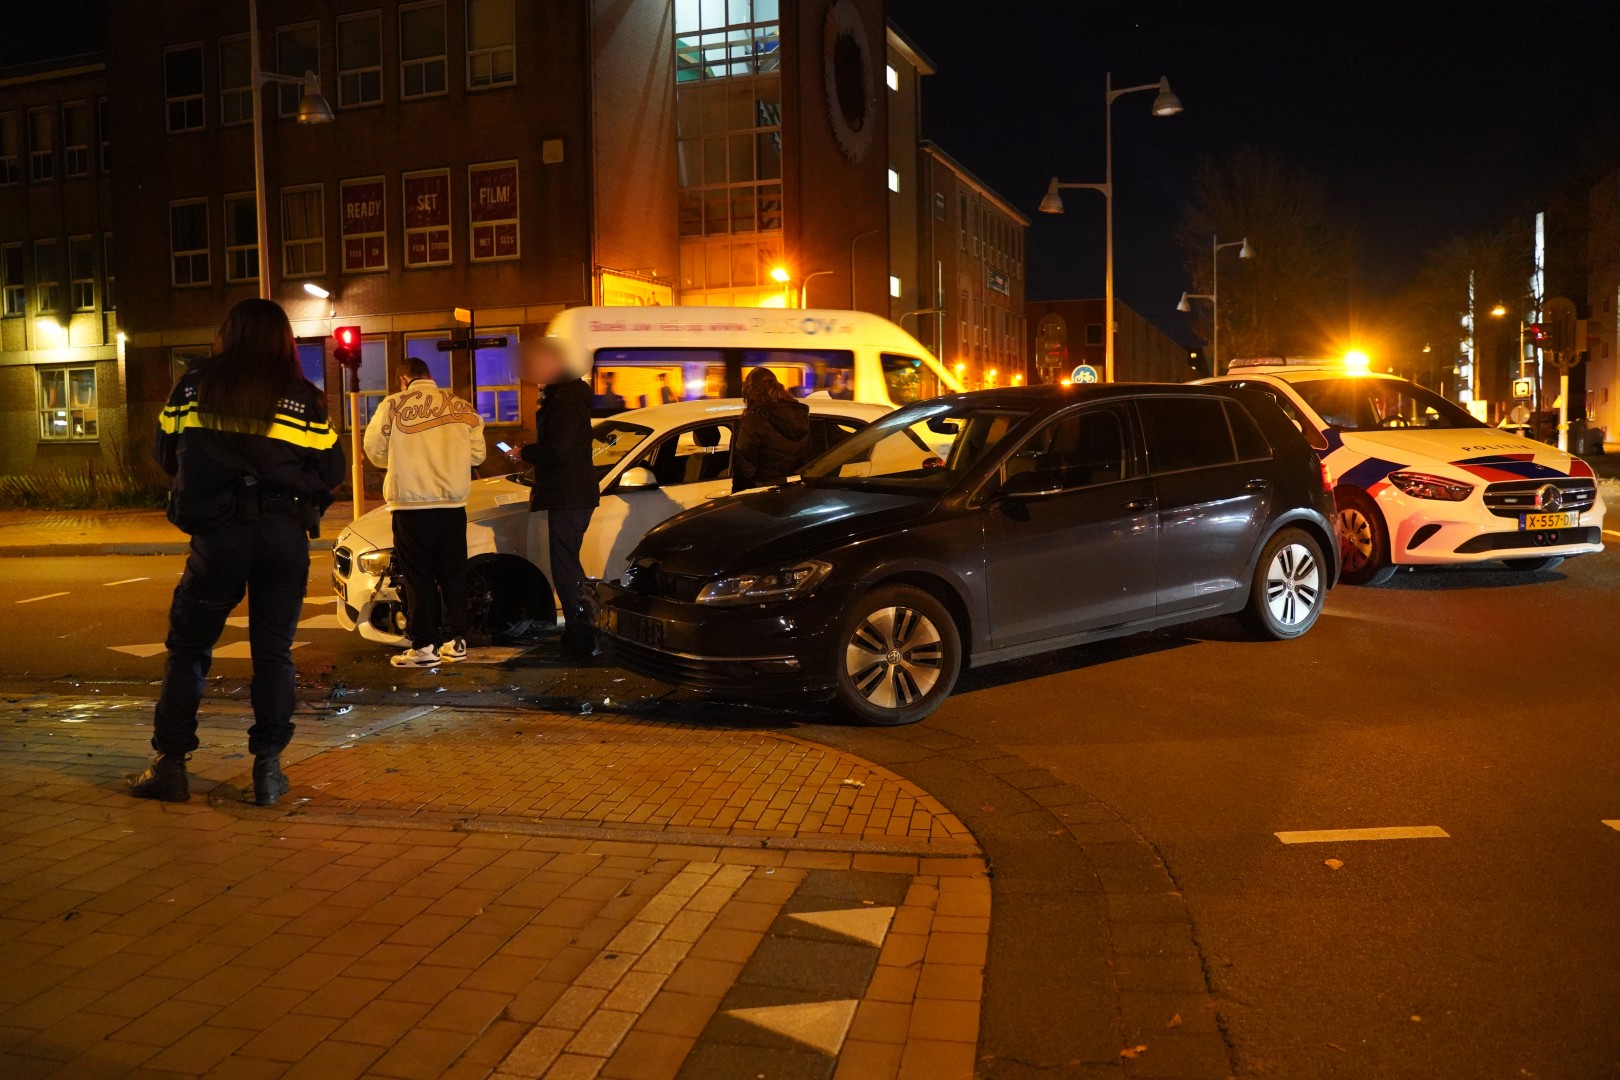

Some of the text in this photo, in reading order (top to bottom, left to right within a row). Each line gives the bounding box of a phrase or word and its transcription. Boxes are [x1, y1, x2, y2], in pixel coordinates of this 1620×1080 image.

[417, 193, 438, 211] SET
[479, 186, 510, 204] FILM!
[347, 200, 381, 219] READY
[412, 244, 425, 253] FILM
[500, 236, 514, 245] SETS
[386, 390, 433, 422] Karl
[1461, 444, 1533, 452] POLITIE
[1529, 513, 1576, 528] X-557-DN
